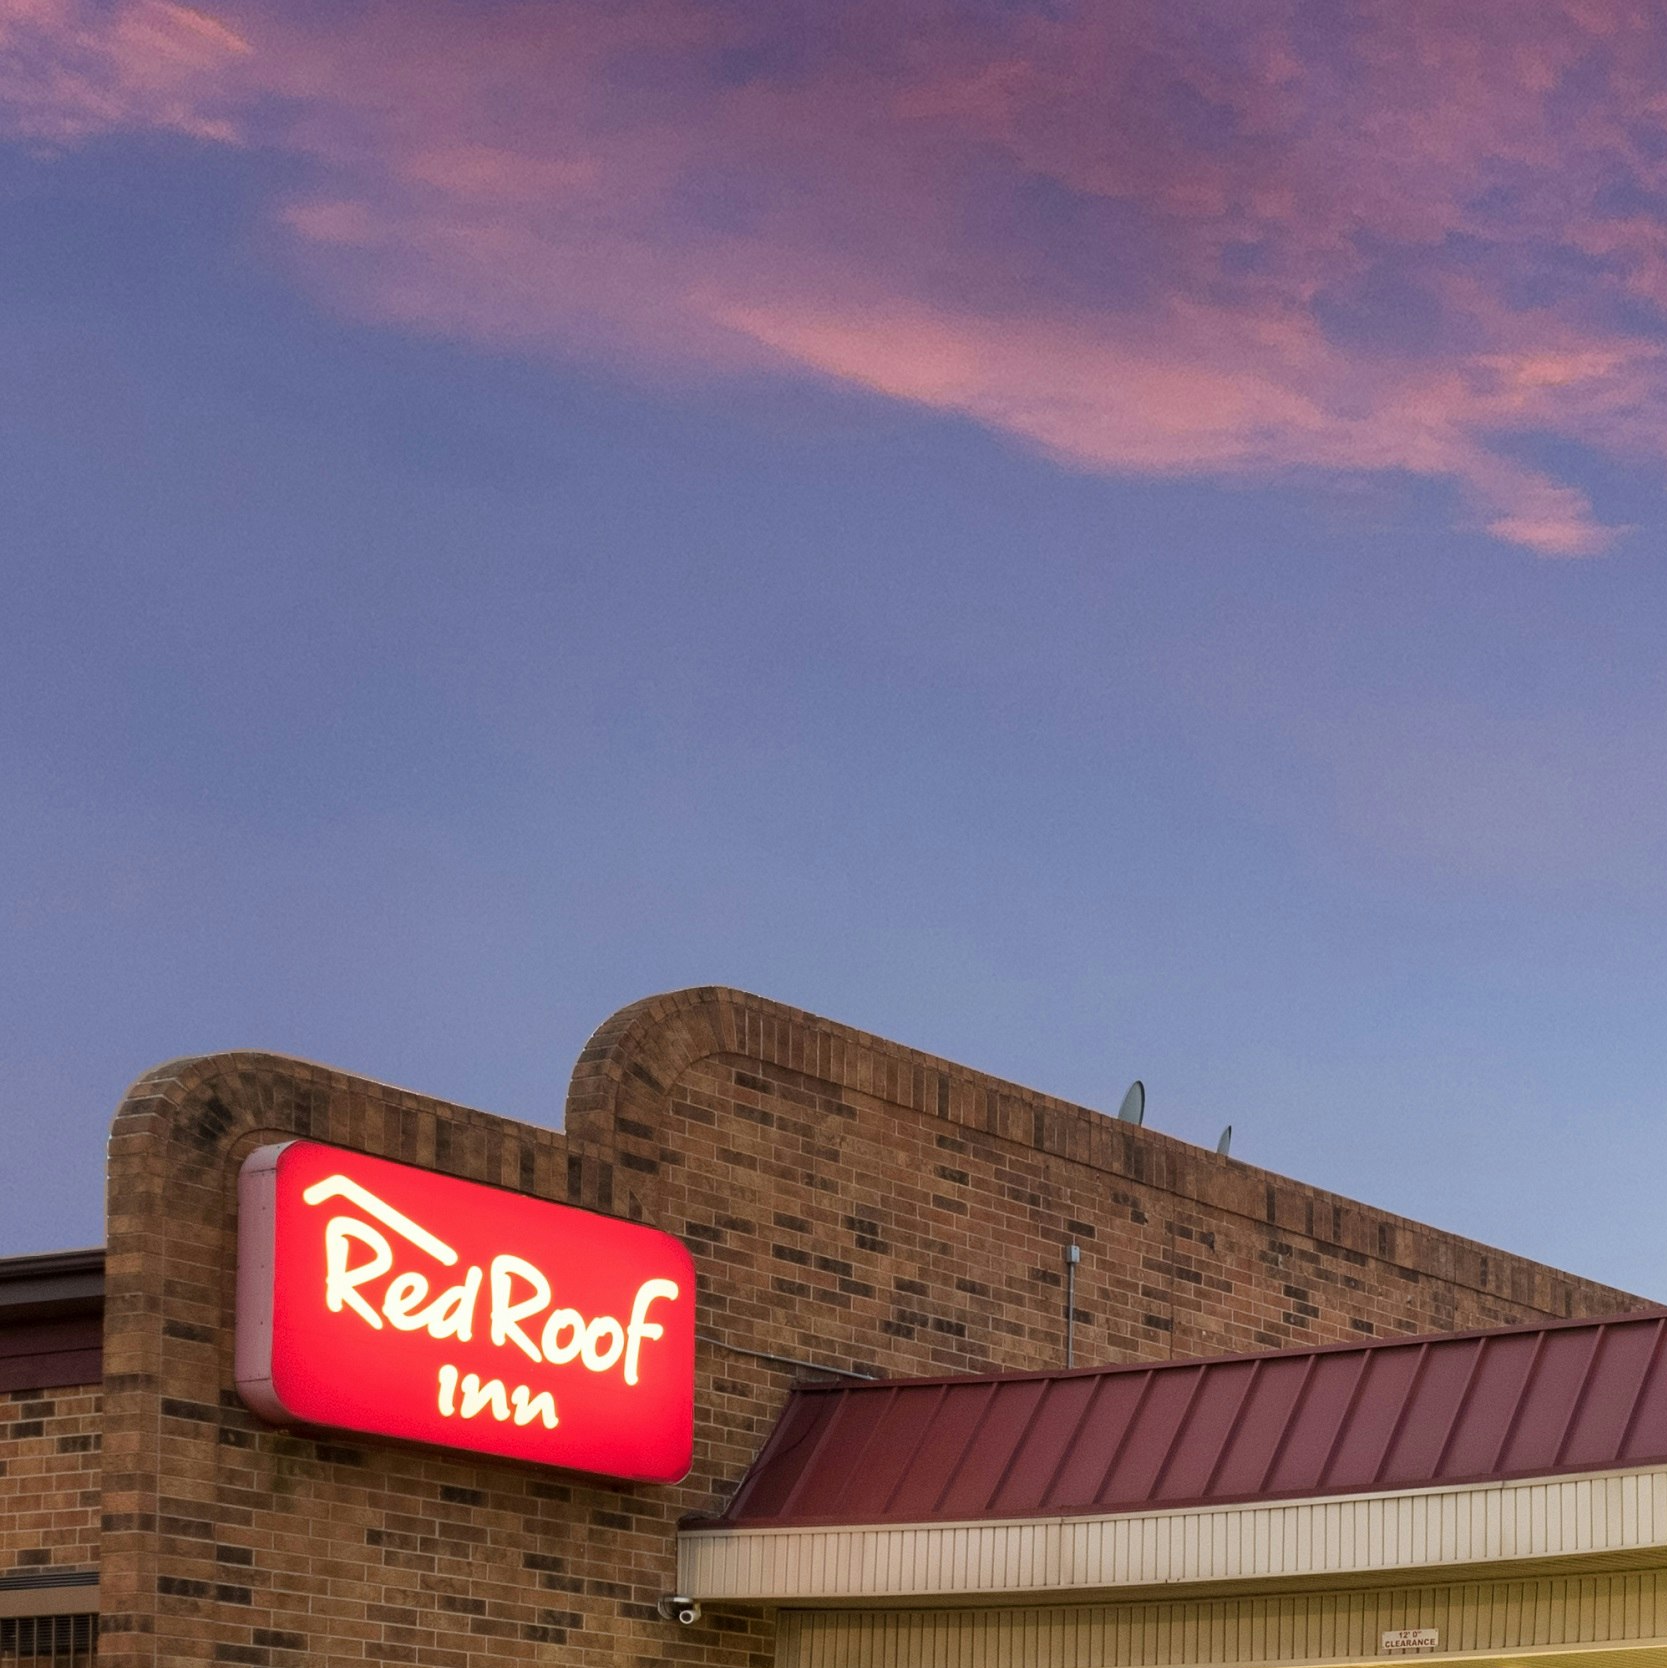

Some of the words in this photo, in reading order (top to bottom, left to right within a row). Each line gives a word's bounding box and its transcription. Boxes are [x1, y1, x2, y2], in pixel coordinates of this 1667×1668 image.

[325, 1215, 482, 1343] Red
[490, 1254, 679, 1386] Roof
[1385, 1638, 1436, 1648] CLEARANCE
